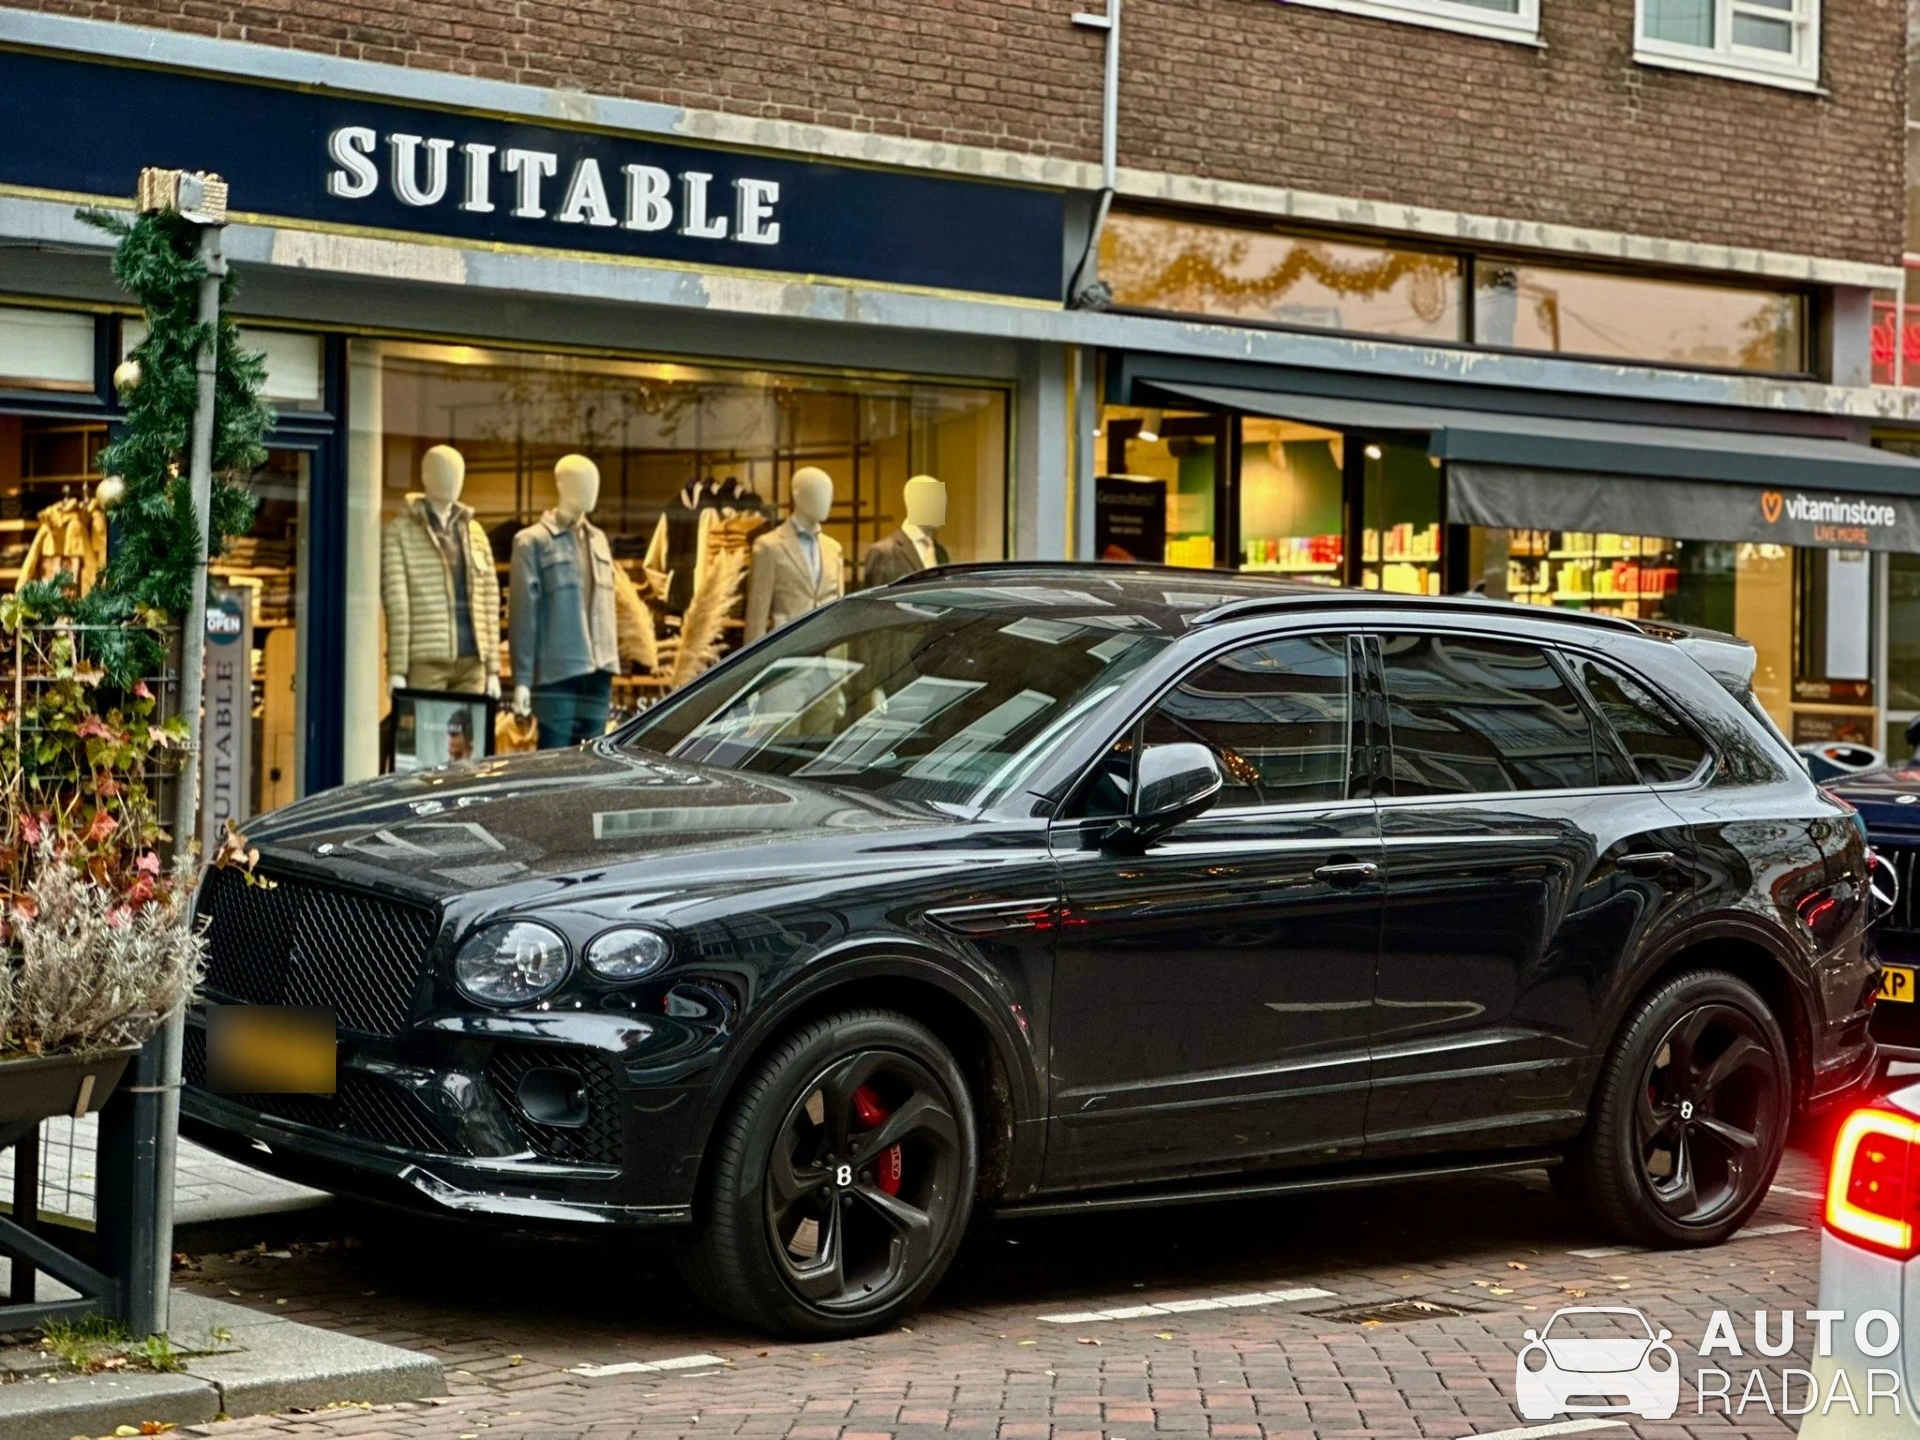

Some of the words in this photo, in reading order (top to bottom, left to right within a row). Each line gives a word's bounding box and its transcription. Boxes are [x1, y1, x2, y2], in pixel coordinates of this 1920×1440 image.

[328, 126, 780, 245] SUITABLE
[1785, 493, 1896, 526] vitaminstore
[1814, 526, 1837, 542] LIVE
[1838, 527, 1869, 543] MORE
[207, 616, 240, 632] OPEN
[213, 661, 233, 843] SUITABLE
